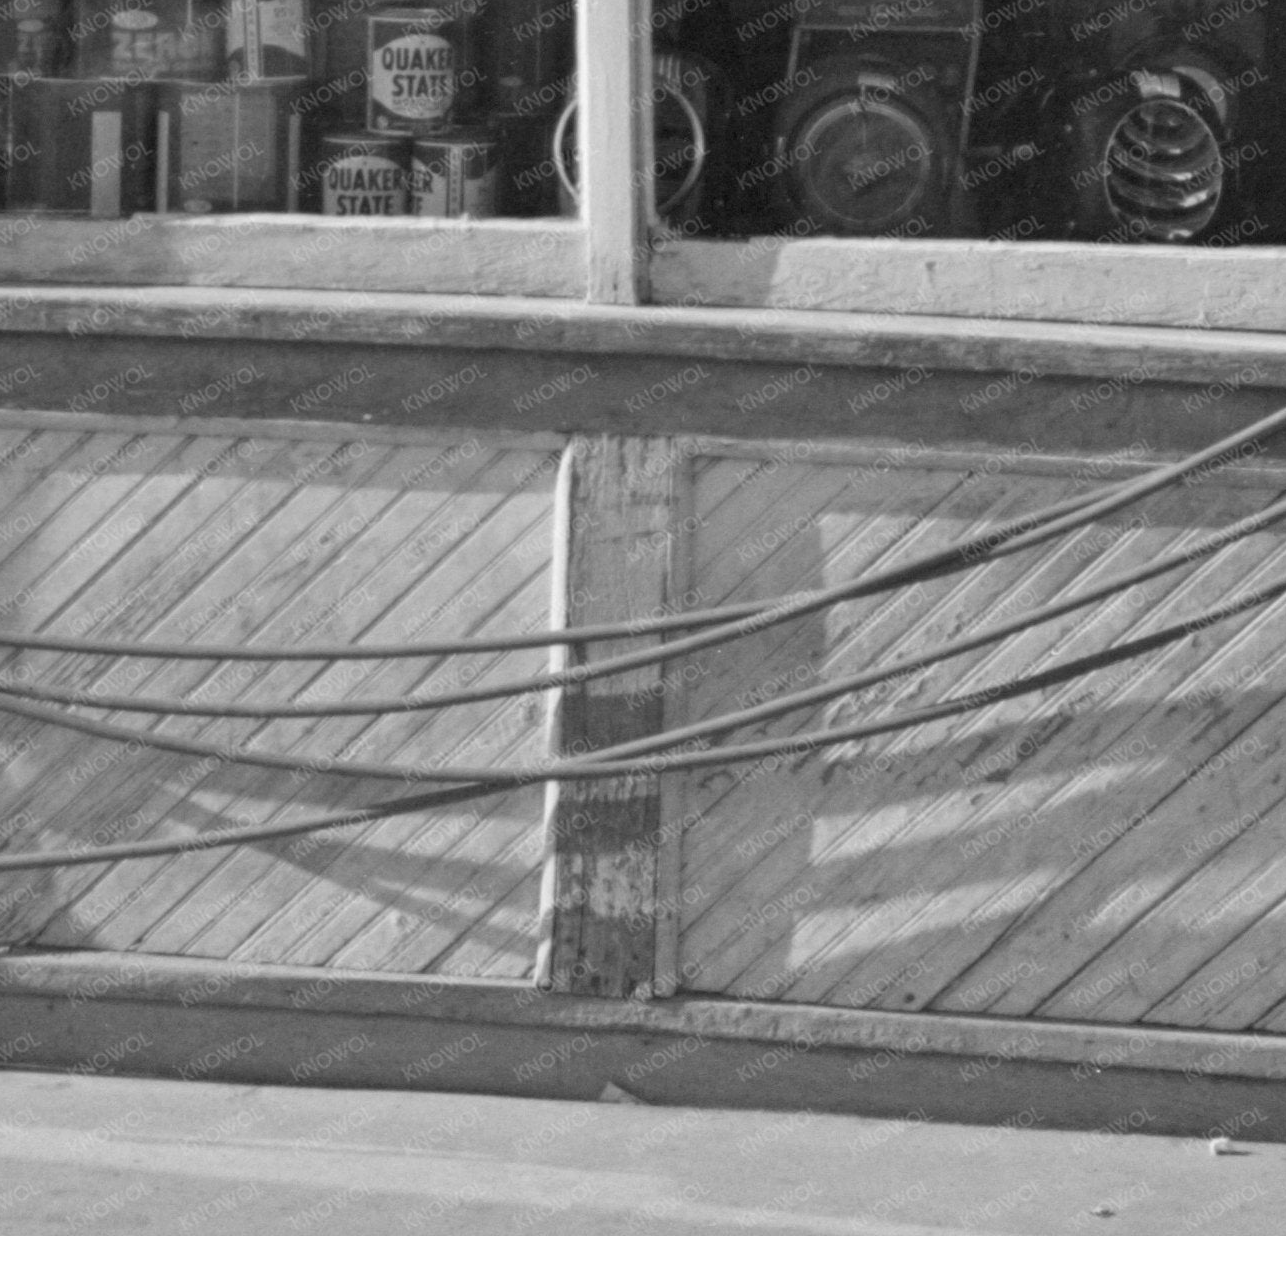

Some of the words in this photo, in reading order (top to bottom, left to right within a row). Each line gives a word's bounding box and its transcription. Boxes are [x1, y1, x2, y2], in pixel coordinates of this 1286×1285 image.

[391, 74, 448, 98] STATE
[328, 167, 404, 192] QUAKER
[335, 195, 394, 216] STATE
